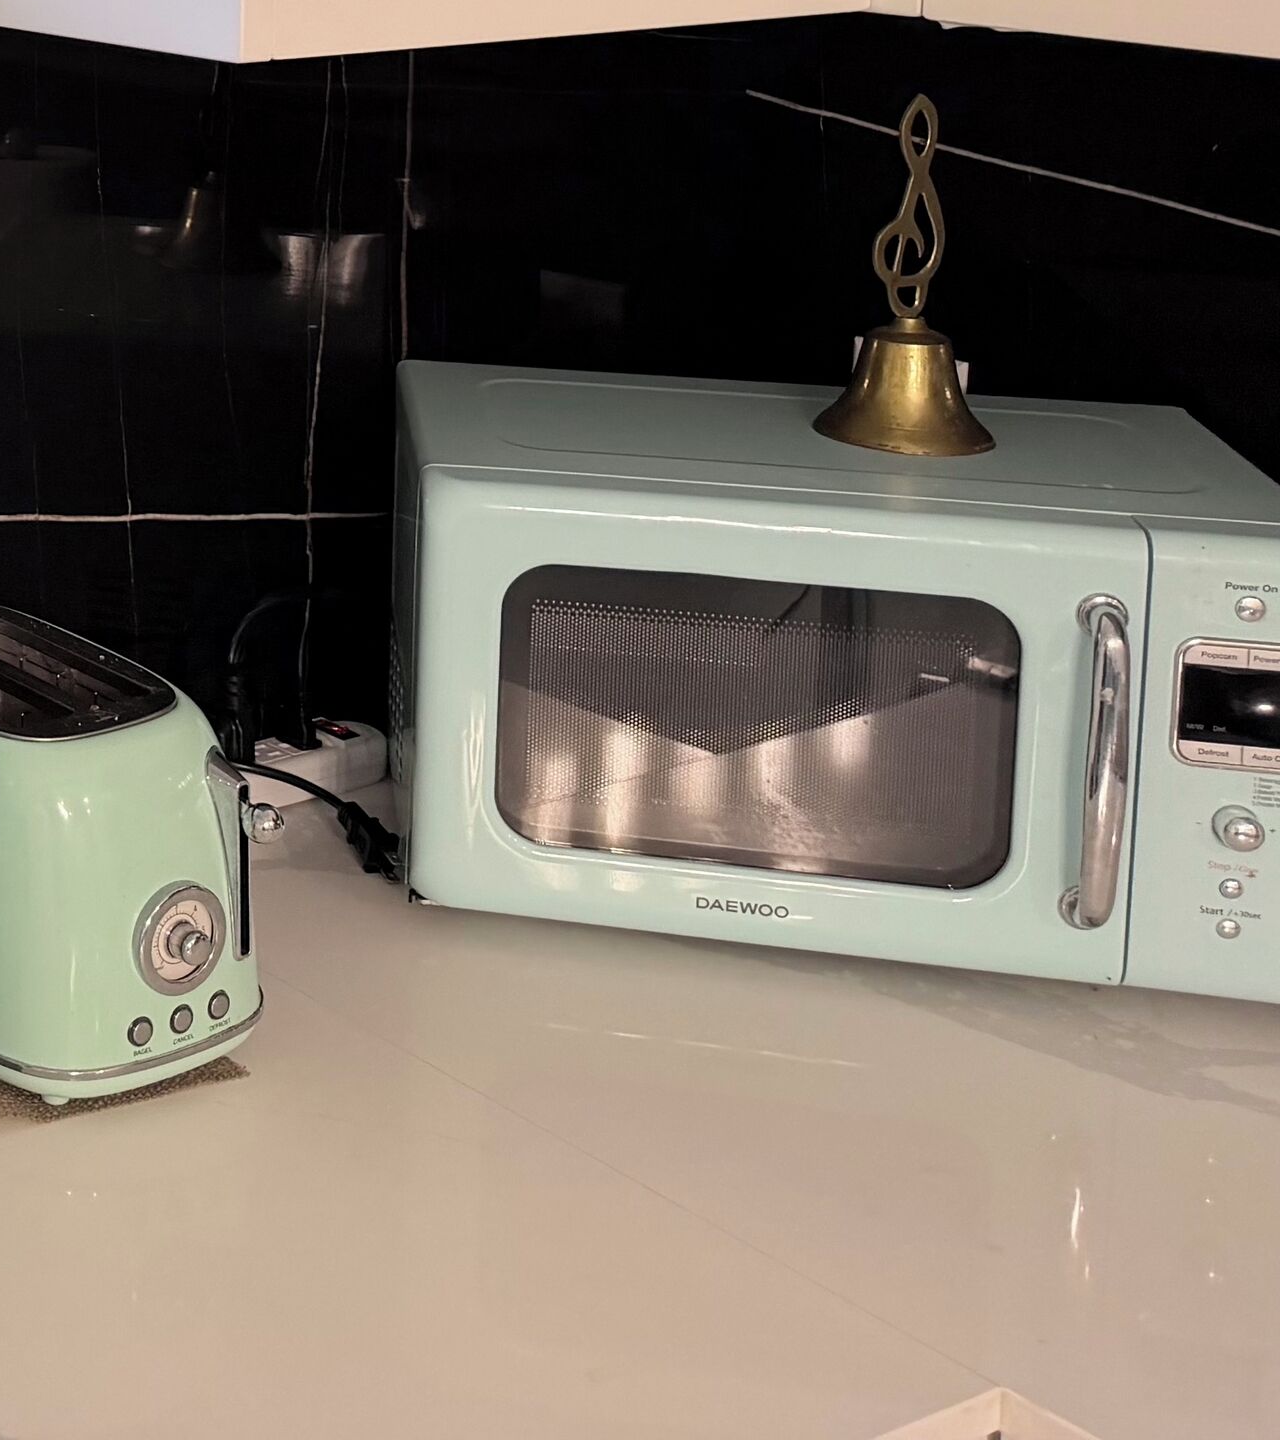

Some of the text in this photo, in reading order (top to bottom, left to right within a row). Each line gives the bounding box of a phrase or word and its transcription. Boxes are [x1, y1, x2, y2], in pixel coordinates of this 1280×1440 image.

[1225, 581, 1278, 592] Power On
[696, 897, 789, 918] DAEWOO
[1200, 905, 1223, 916] Start
[173, 1034, 194, 1045] CANCEL
[133, 1047, 152, 1057] BAGEL
